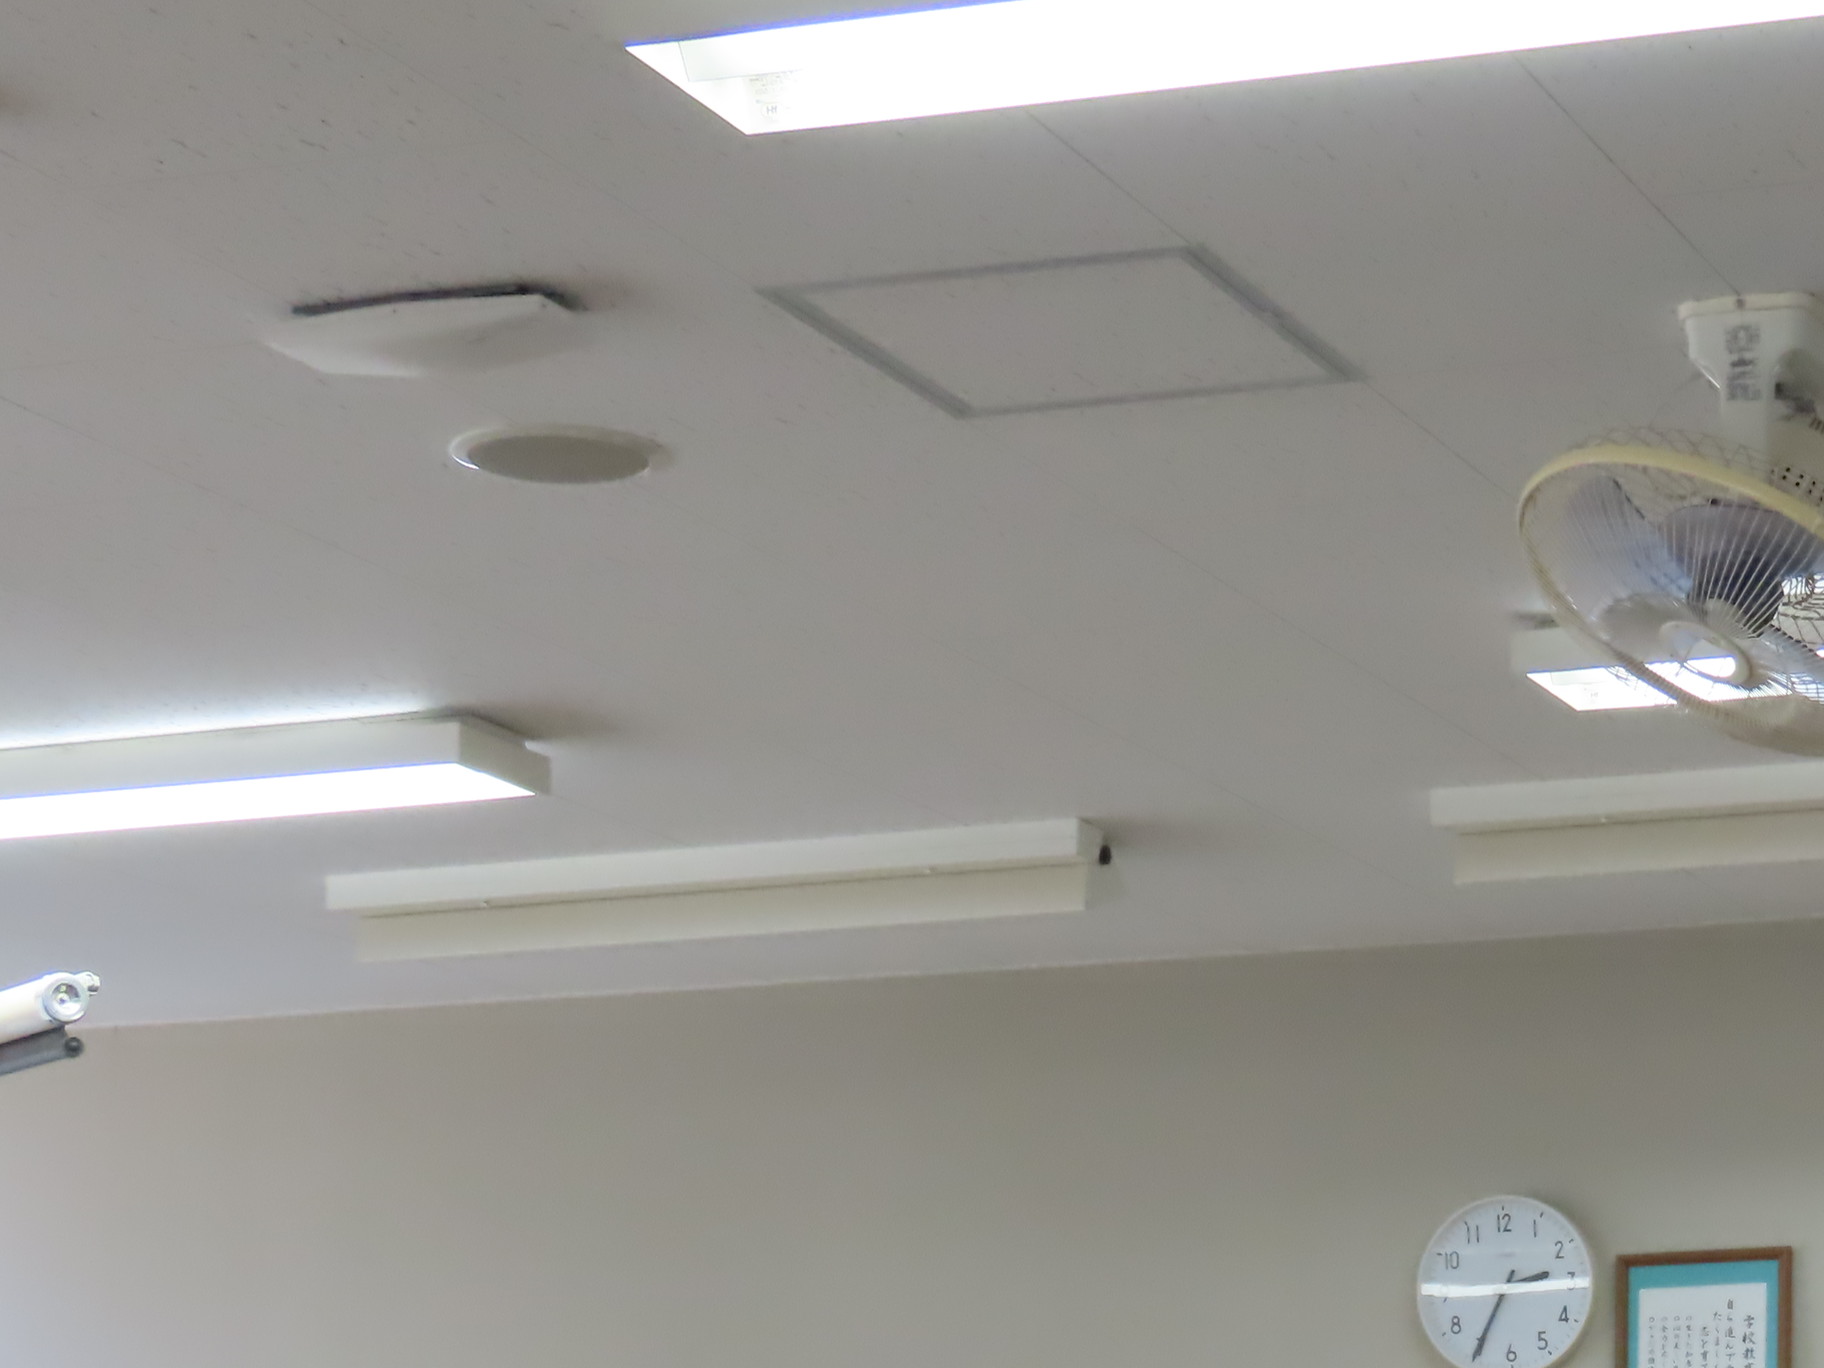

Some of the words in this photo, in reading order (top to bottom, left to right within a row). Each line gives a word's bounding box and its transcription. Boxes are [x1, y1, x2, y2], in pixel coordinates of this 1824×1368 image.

[1497, 1213, 1512, 1233] 12
[1465, 1224, 1480, 1244] 11
[1554, 1241, 1565, 1259] 2
[1444, 1251, 1460, 1270] 10
[1558, 1305, 1570, 1323] 4
[1450, 1315, 1462, 1335] 8
[1537, 1331, 1548, 1351] 5
[1505, 1344, 1517, 1363] 6
